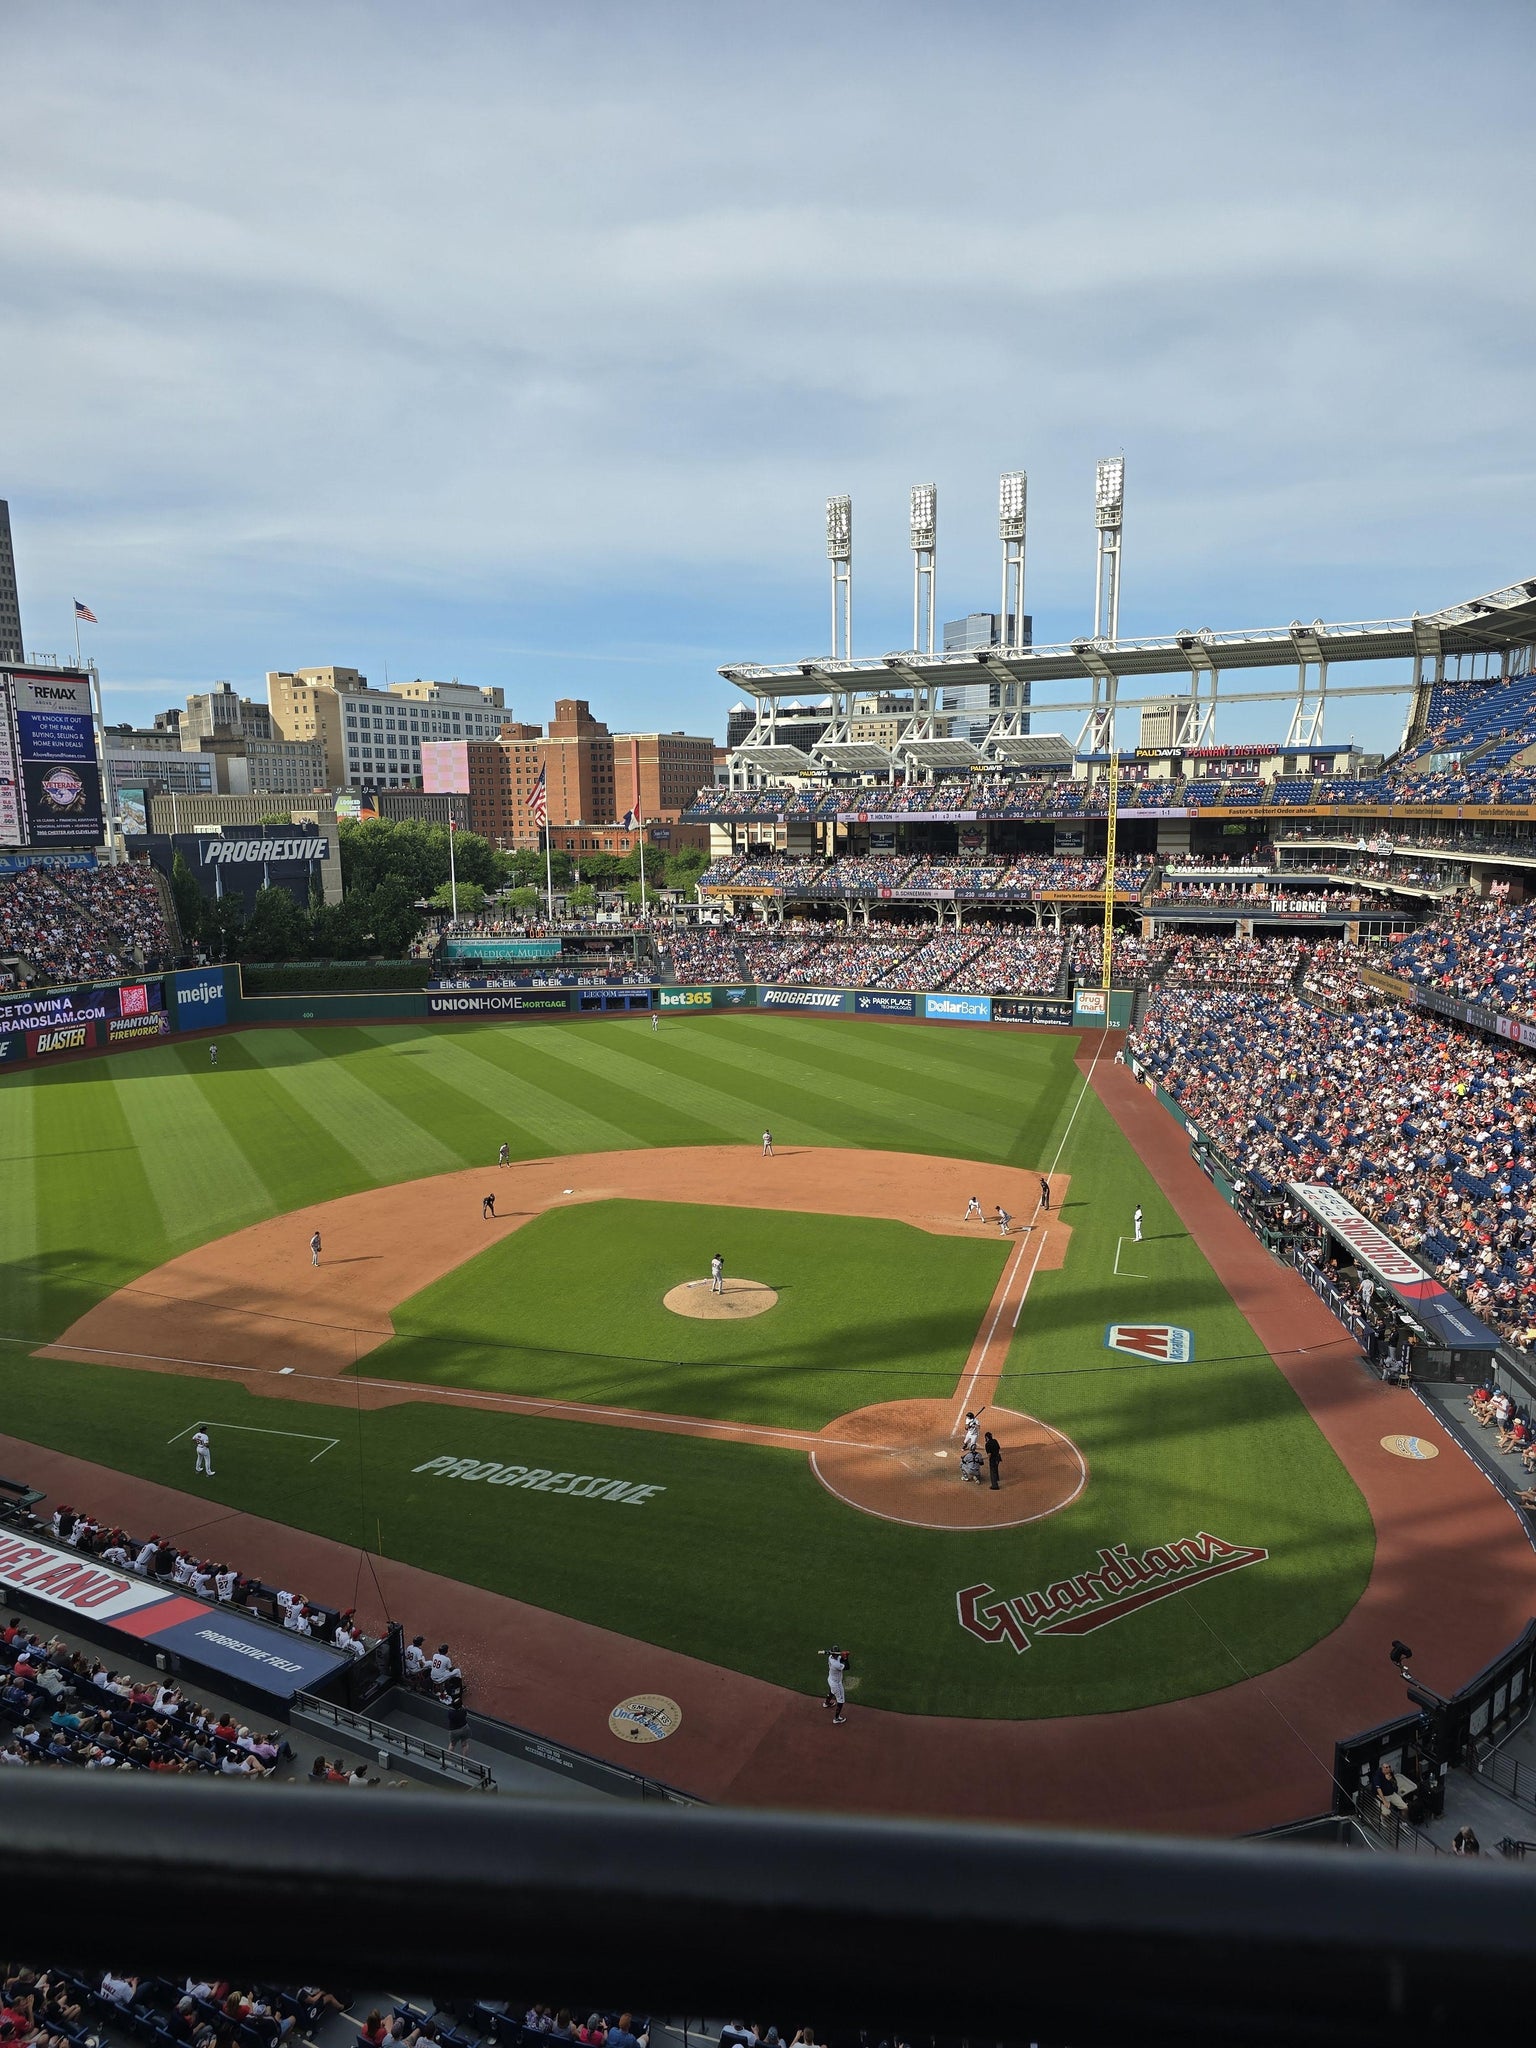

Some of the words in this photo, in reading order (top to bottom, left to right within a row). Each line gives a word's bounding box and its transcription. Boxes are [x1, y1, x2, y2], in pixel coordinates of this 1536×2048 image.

[1186, 747, 1231, 758] PENNANT
[1233, 743, 1281, 757] DISTRICT
[43, 781, 80, 789] VETERANS
[204, 839, 329, 864] PROGRESSIVE
[1271, 901, 1288, 912] THE
[1289, 900, 1328, 914] CORNER
[177, 982, 223, 1005] meijer
[660, 992, 712, 1005] bet365
[764, 990, 842, 1007] PROGRESSIVE
[872, 997, 889, 1005] PARK
[890, 998, 912, 1006] PLACE
[14, 1003, 32, 1016] TO
[33, 999, 61, 1014] WIN
[63, 998, 73, 1010] A
[522, 1000, 567, 1009] MORTGAGE
[0, 1006, 106, 1033] RANDSLAM.COM
[109, 1014, 159, 1031] PHANTOM
[1108, 1020, 1121, 1028] 325
[36, 1028, 86, 1054] BLASTER
[109, 1025, 159, 1042] FIREWORKS
[1331, 1217, 1420, 1275] GUARDIANS
[1169, 1329, 1184, 1361] Marathon
[411, 1456, 667, 1505] PROGRESSIVE
[957, 1531, 1269, 1656] Guardians
[194, 1629, 272, 1661] PROGRESSIVE
[262, 1656, 303, 1673] FIELD
